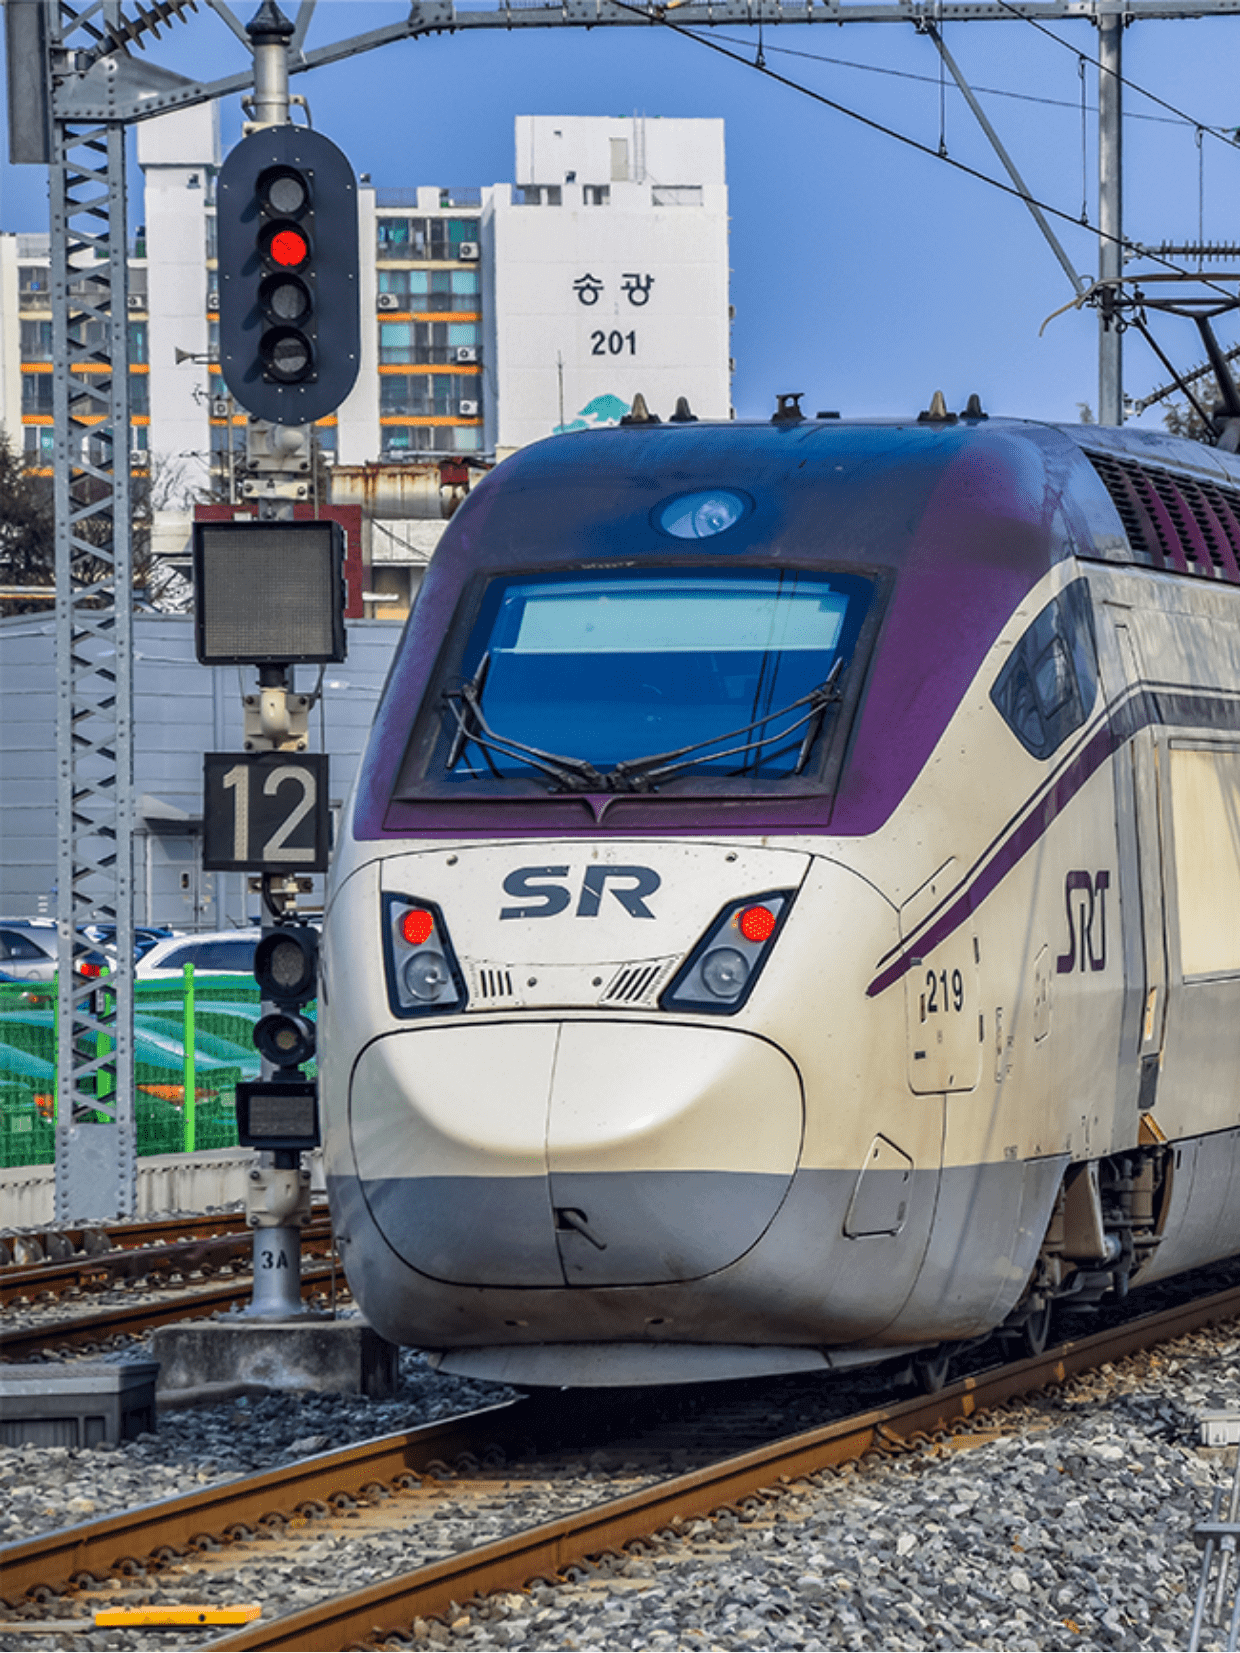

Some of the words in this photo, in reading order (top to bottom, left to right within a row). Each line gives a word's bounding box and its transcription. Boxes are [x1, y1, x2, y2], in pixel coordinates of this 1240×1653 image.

[591, 330, 636, 355] 201
[223, 765, 317, 862] 12
[499, 865, 662, 920] SR
[1057, 870, 1110, 974] SRT
[926, 969, 963, 1013] 219
[261, 1250, 288, 1269] 3A
